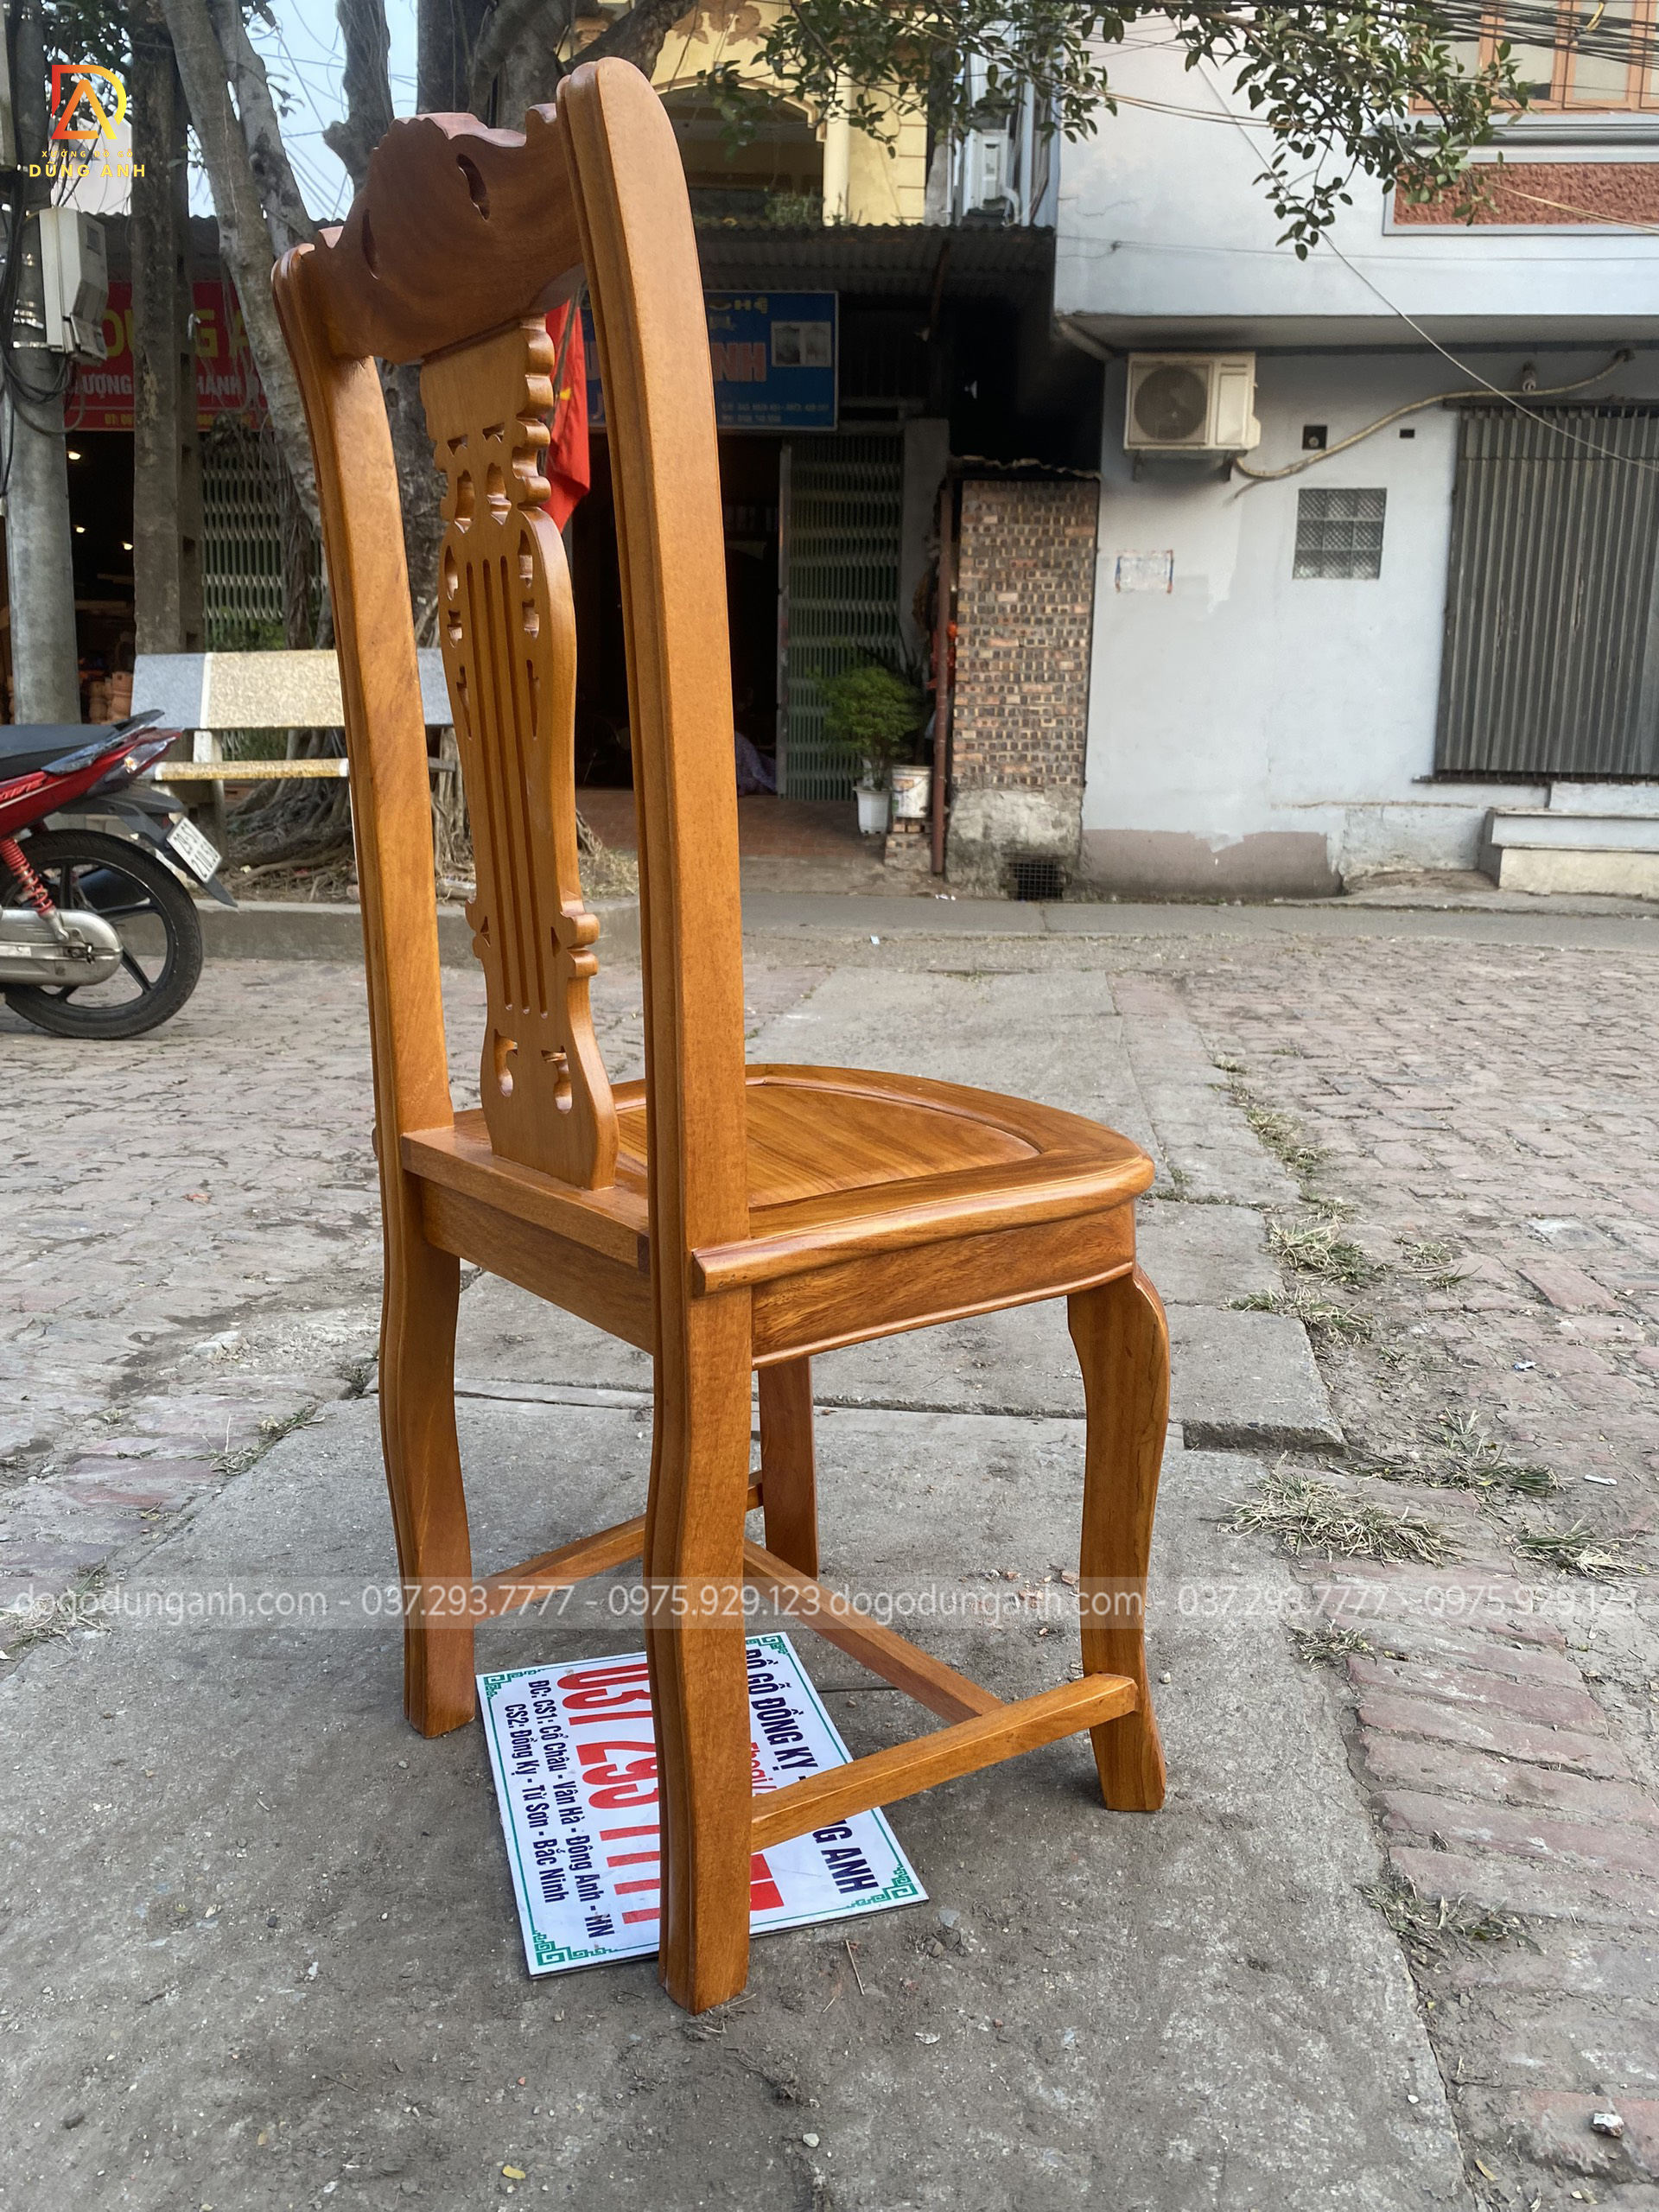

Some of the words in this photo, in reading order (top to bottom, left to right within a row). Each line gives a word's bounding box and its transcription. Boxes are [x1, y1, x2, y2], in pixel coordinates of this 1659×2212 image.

[528, 1680, 551, 1698] ĐC:
[505, 1704, 529, 1728] CS2:
[533, 1700, 557, 1724] CS1:
[751, 1697, 804, 1745] ĐỒNG
[510, 1729, 537, 1758] Đồng
[539, 1726, 569, 1740] Cổ
[543, 1742, 569, 1771] Châu
[522, 1784, 547, 1801] Từ
[553, 1781, 578, 1805] Vân
[525, 1802, 550, 1828] Sơn
[558, 1807, 585, 1825] Hà
[532, 1839, 566, 1866] Bắc
[565, 1835, 593, 1871] Đông
[821, 1847, 879, 1894] ANH
[539, 1867, 569, 1903] Ninh
[575, 1874, 604, 1902] Anh
[584, 1914, 615, 1938] HN
